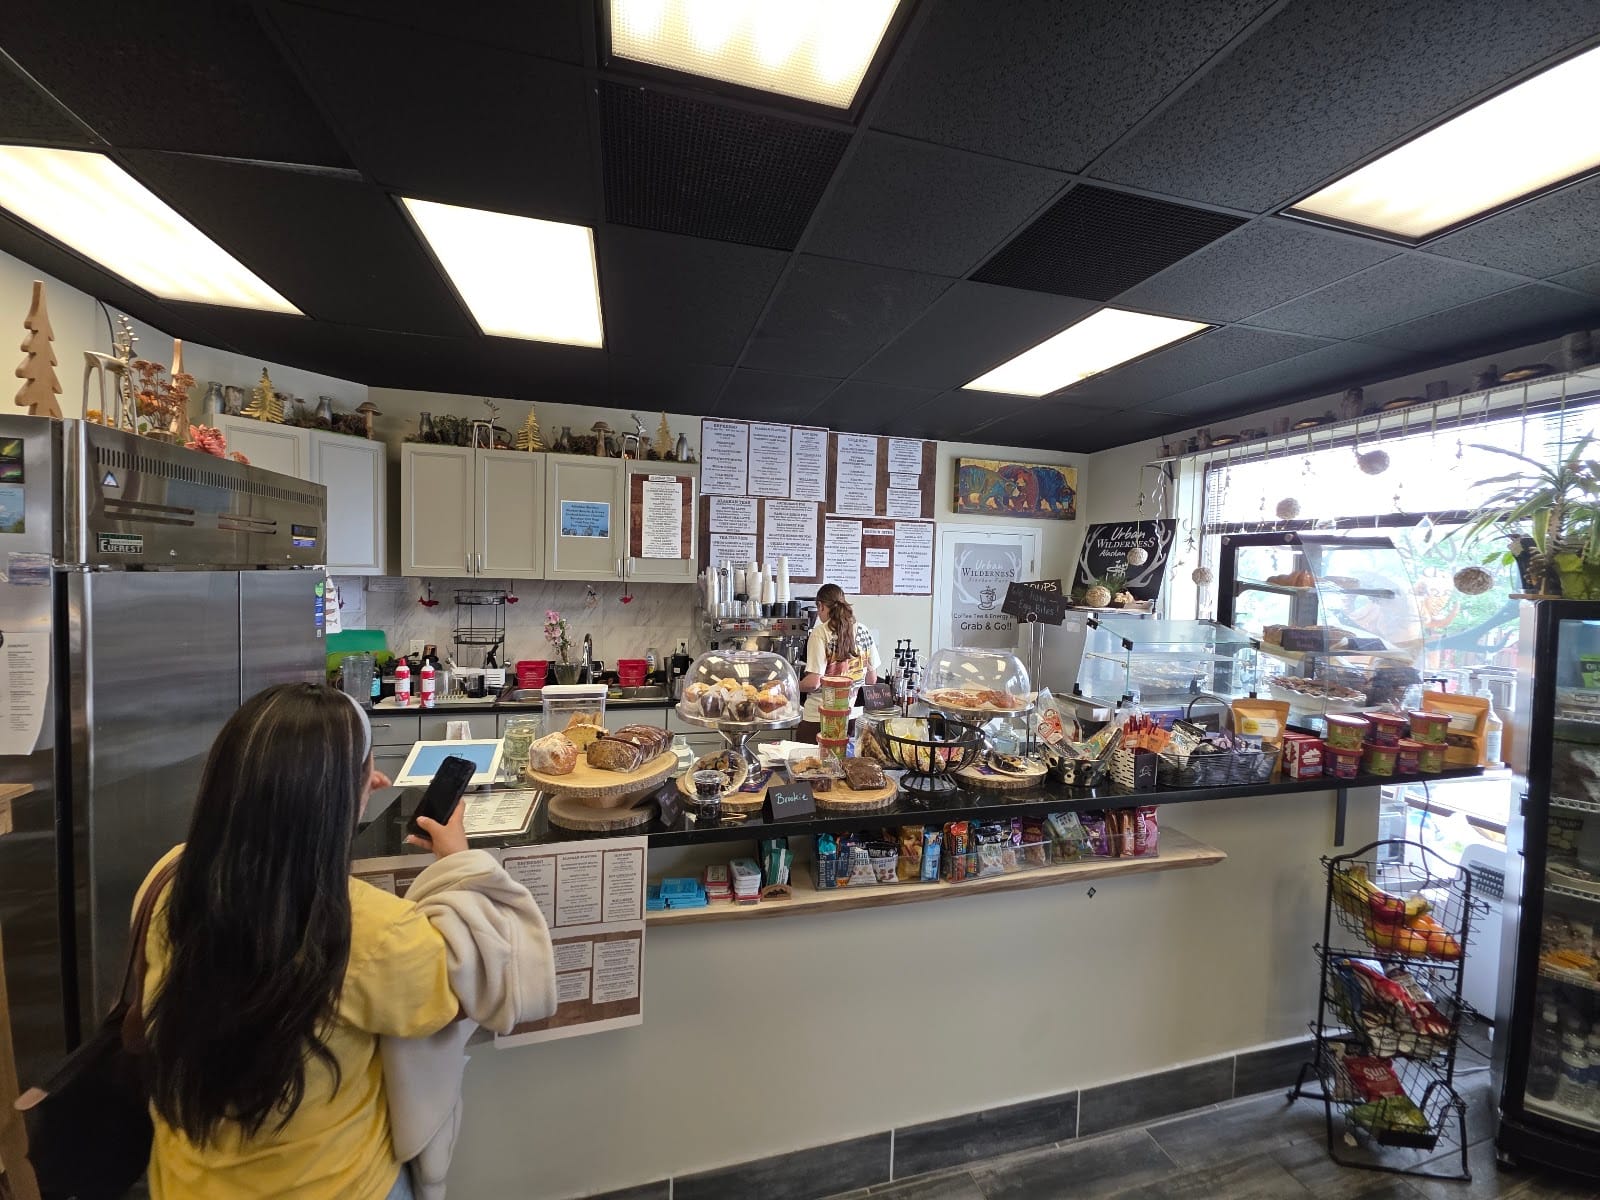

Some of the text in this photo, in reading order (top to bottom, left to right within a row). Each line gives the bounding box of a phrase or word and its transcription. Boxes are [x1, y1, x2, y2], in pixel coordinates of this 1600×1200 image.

[1111, 526, 1146, 541] Urban
[100, 539, 141, 553] EVEREST
[1097, 537, 1156, 548] WILDERNESS
[975, 559, 1004, 570] Urban
[961, 567, 1015, 578] WILDERNESS
[960, 621, 1012, 631] Grab & Go!!
[775, 791, 809, 805] Brookie
